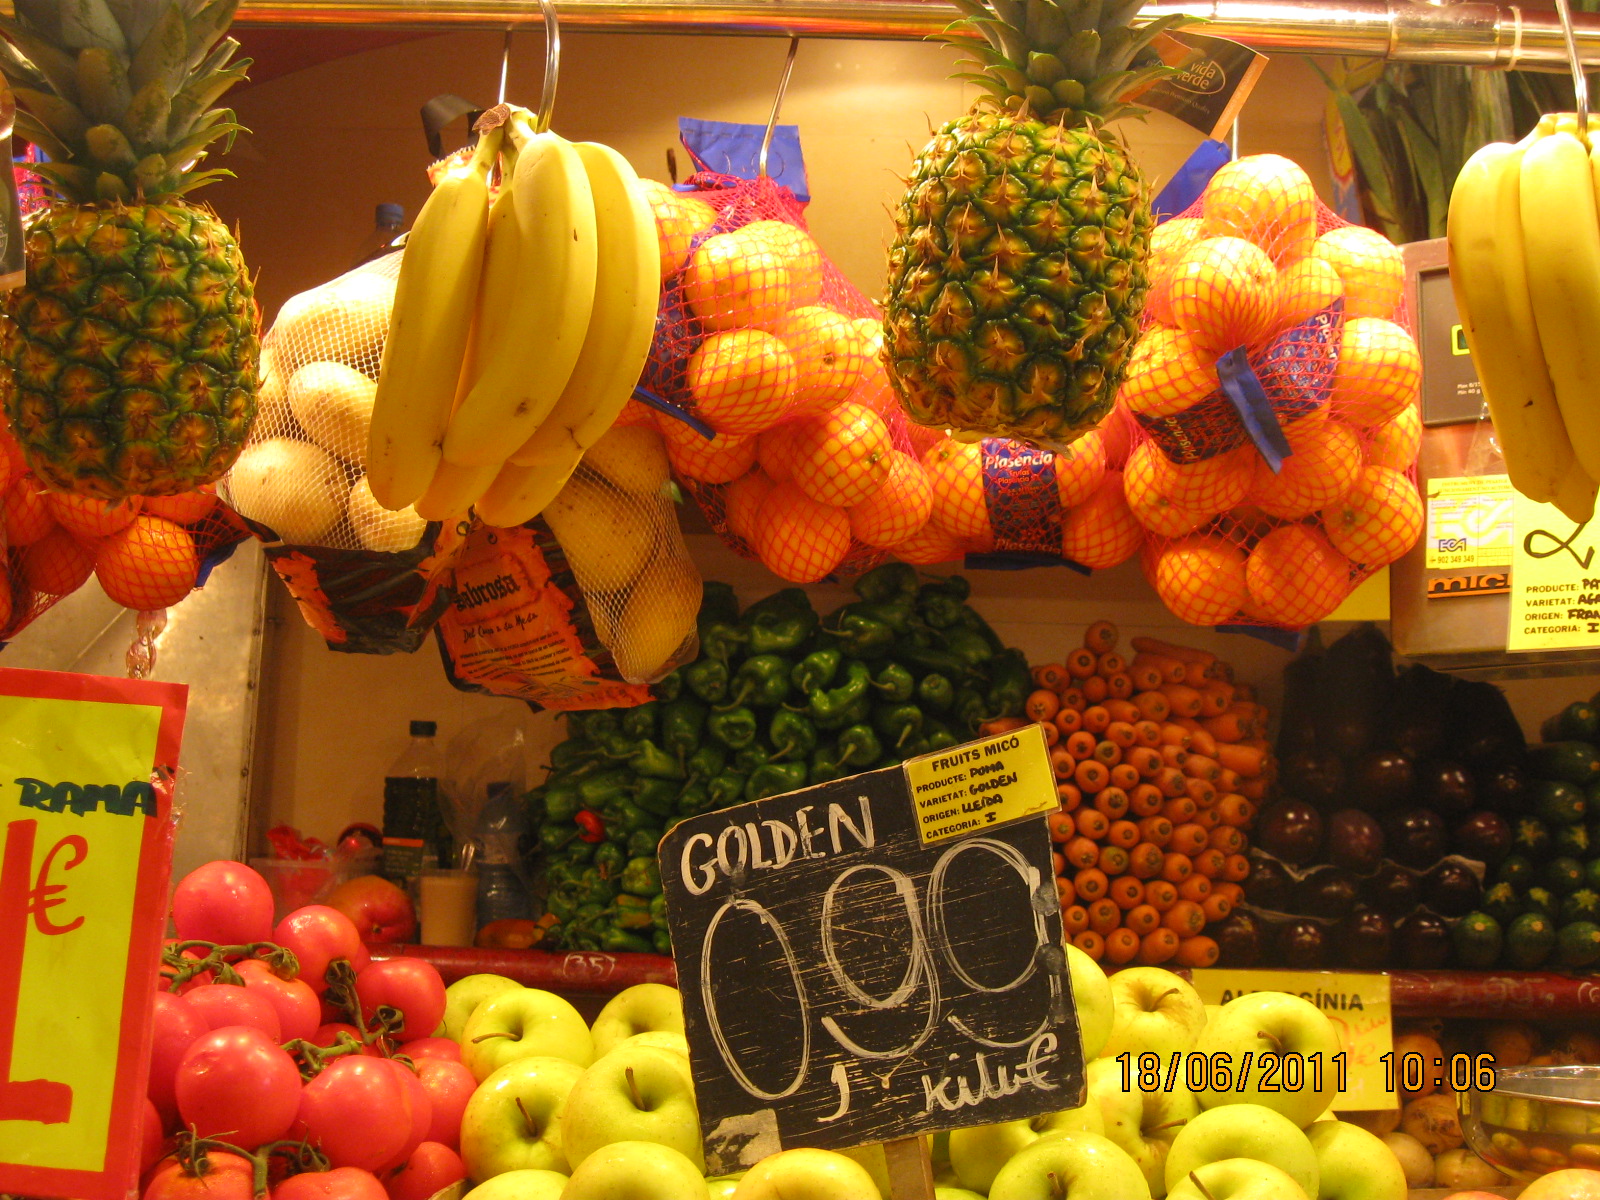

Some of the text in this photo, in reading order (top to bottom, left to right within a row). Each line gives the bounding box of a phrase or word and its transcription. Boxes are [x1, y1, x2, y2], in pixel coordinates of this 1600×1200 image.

[1190, 60, 1217, 79] vida
[1177, 72, 1210, 90] verde
[985, 453, 1053, 469] Plasencia
[1437, 555, 1449, 564] 902
[1526, 584, 1579, 593] PRODUCTE:
[1525, 597, 1575, 607] VARIETAT:
[1524, 612, 1563, 621] ORIGEN:
[1524, 625, 1581, 635] CATEGORIA:
[932, 735, 1020, 772] FRUITS MICÓ
[916, 761, 1005, 794] PRODUCTE: POMA
[14, 777, 158, 817] RAMA
[919, 772, 1018, 809] VARIETAT: GOLDEN
[922, 807, 960, 824] ORIGEN:
[926, 818, 981, 839] CATEGORIA:
[681, 796, 875, 895] GOLDEN
